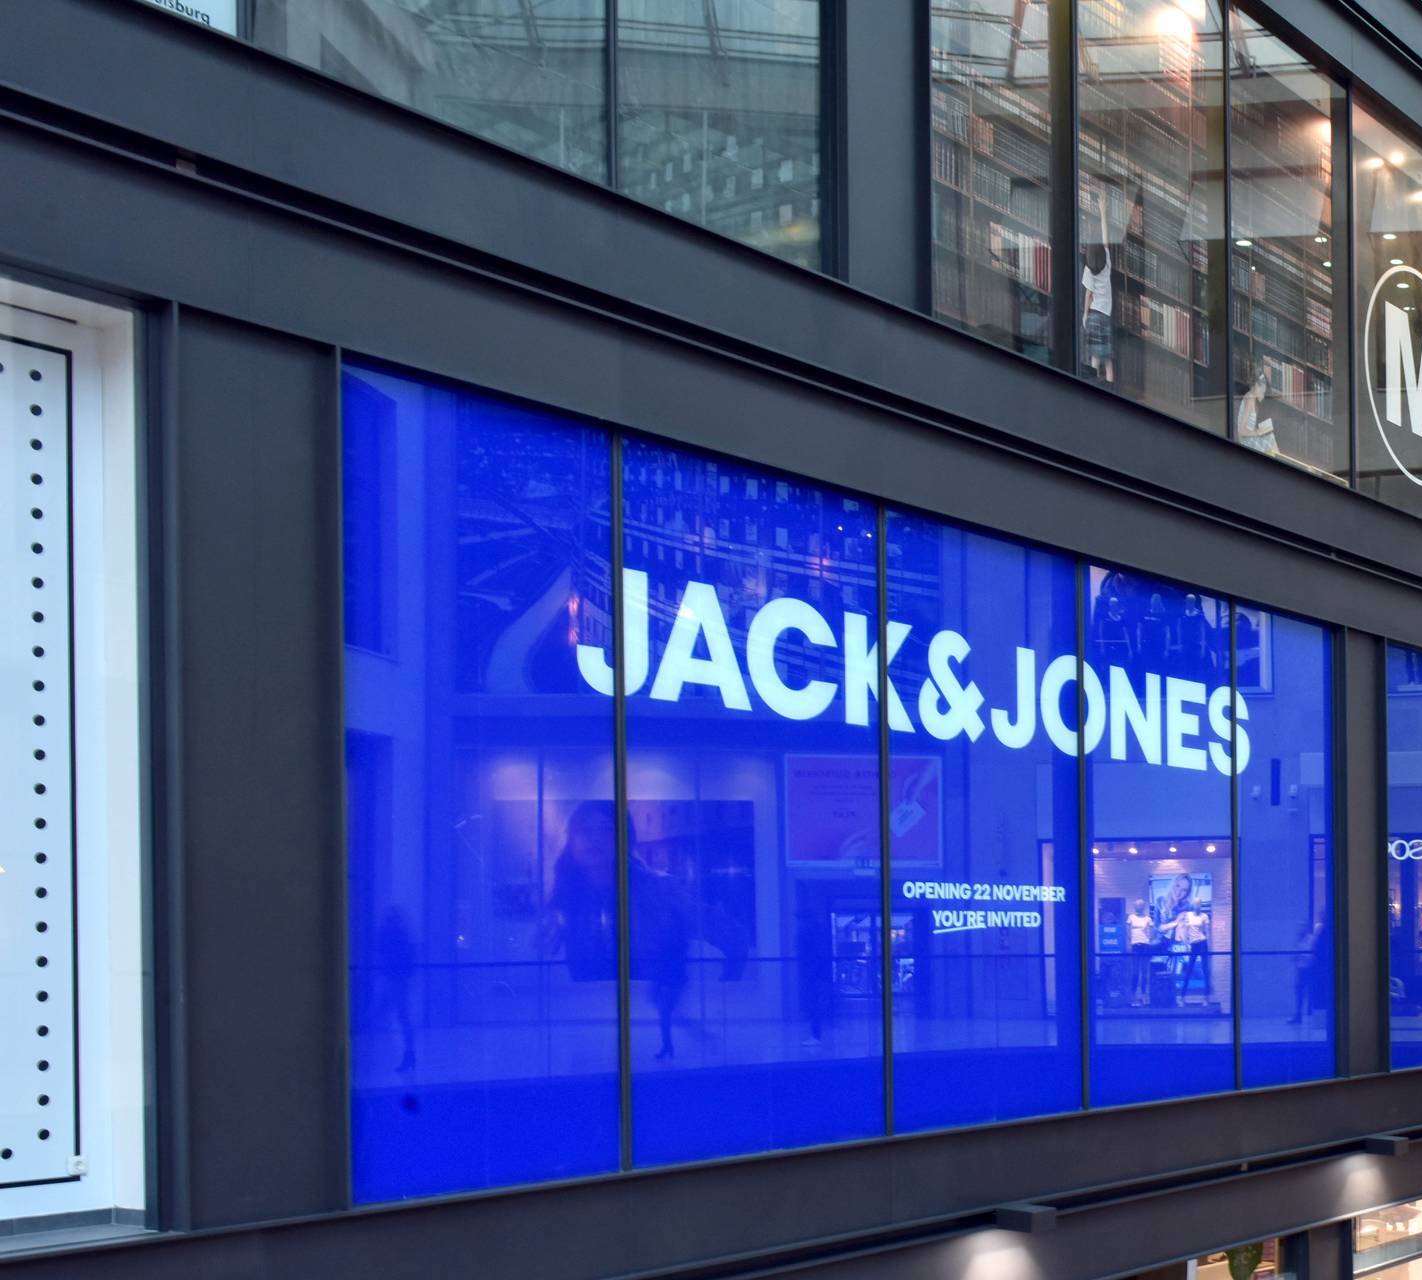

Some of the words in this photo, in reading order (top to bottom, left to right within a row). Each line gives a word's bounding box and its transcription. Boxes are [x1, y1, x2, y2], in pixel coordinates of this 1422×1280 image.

[903, 881, 971, 899] OPENING
[974, 884, 990, 900] 22
[993, 885, 1065, 902] NOVEMBER
[933, 910, 986, 929] YOU'RE
[987, 911, 1041, 927] INVITED
